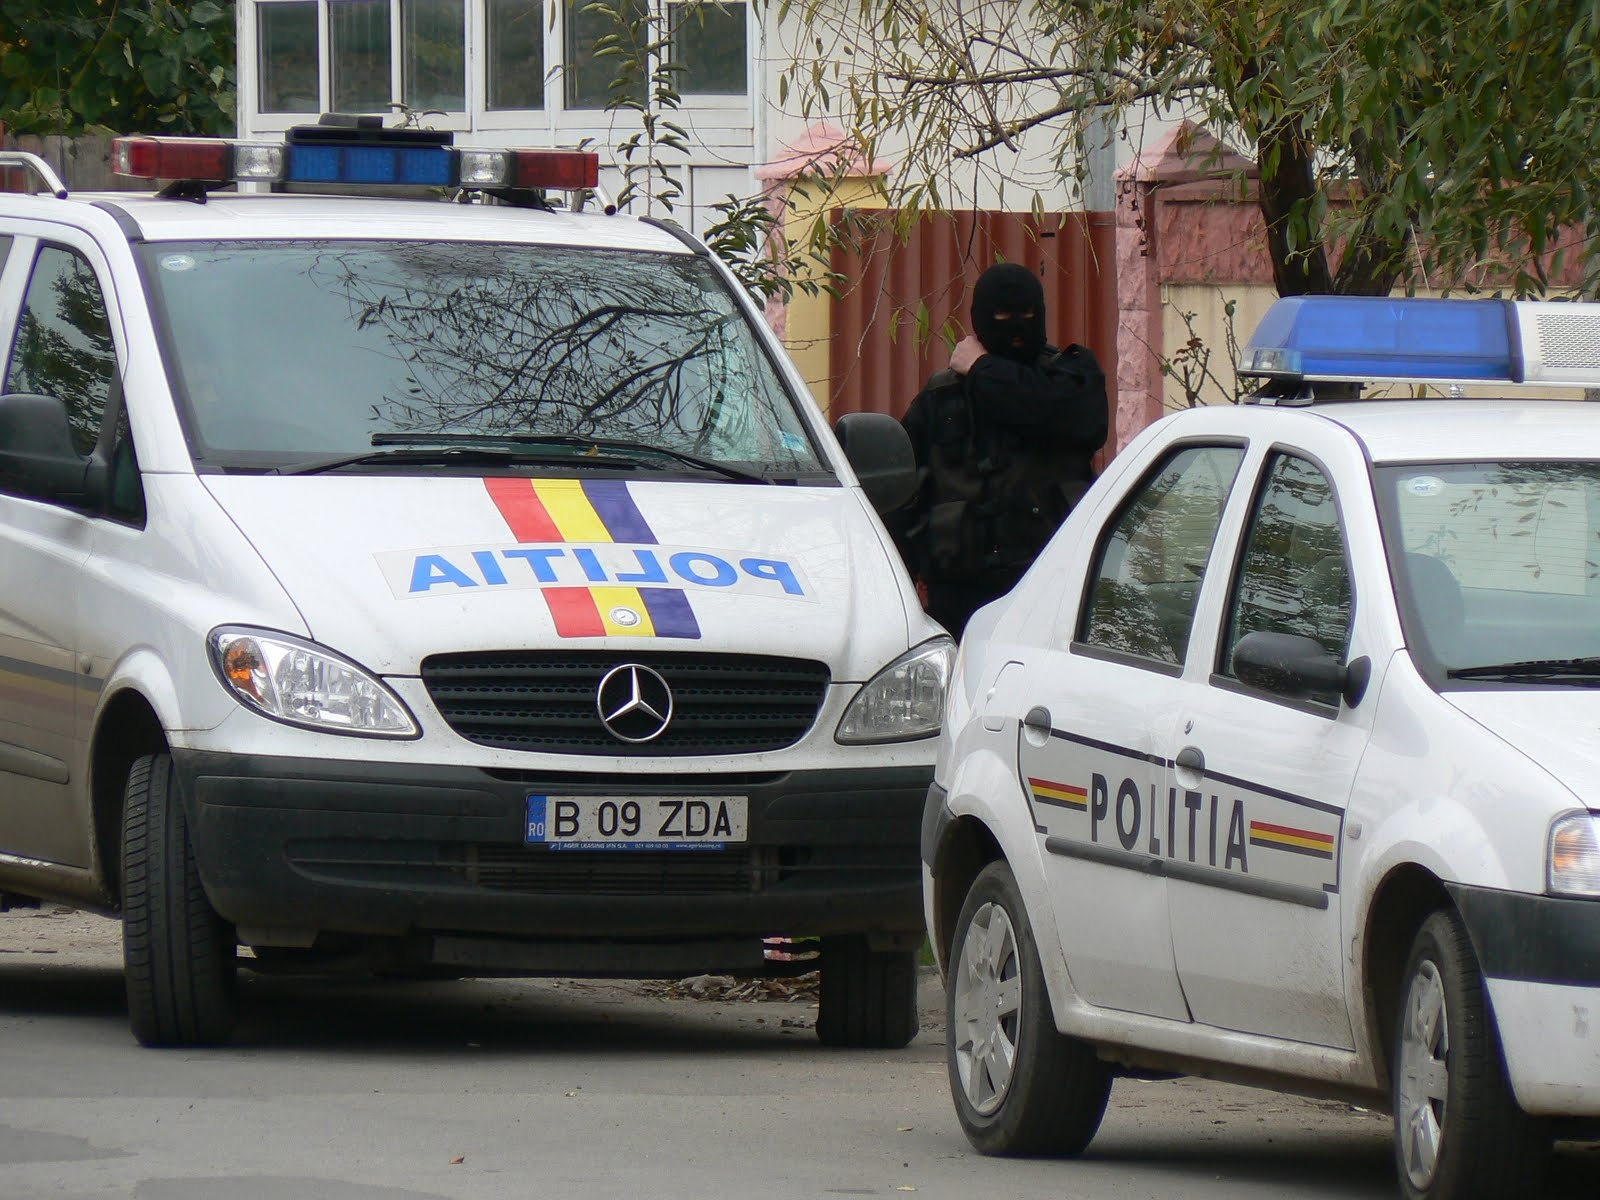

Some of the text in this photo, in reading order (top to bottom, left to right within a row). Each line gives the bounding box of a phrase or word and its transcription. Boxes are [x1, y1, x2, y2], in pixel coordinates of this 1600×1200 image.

[528, 822, 544, 837] RO
[554, 800, 732, 837] B 09 ZDA
[1091, 772, 1248, 873] POLITIA
